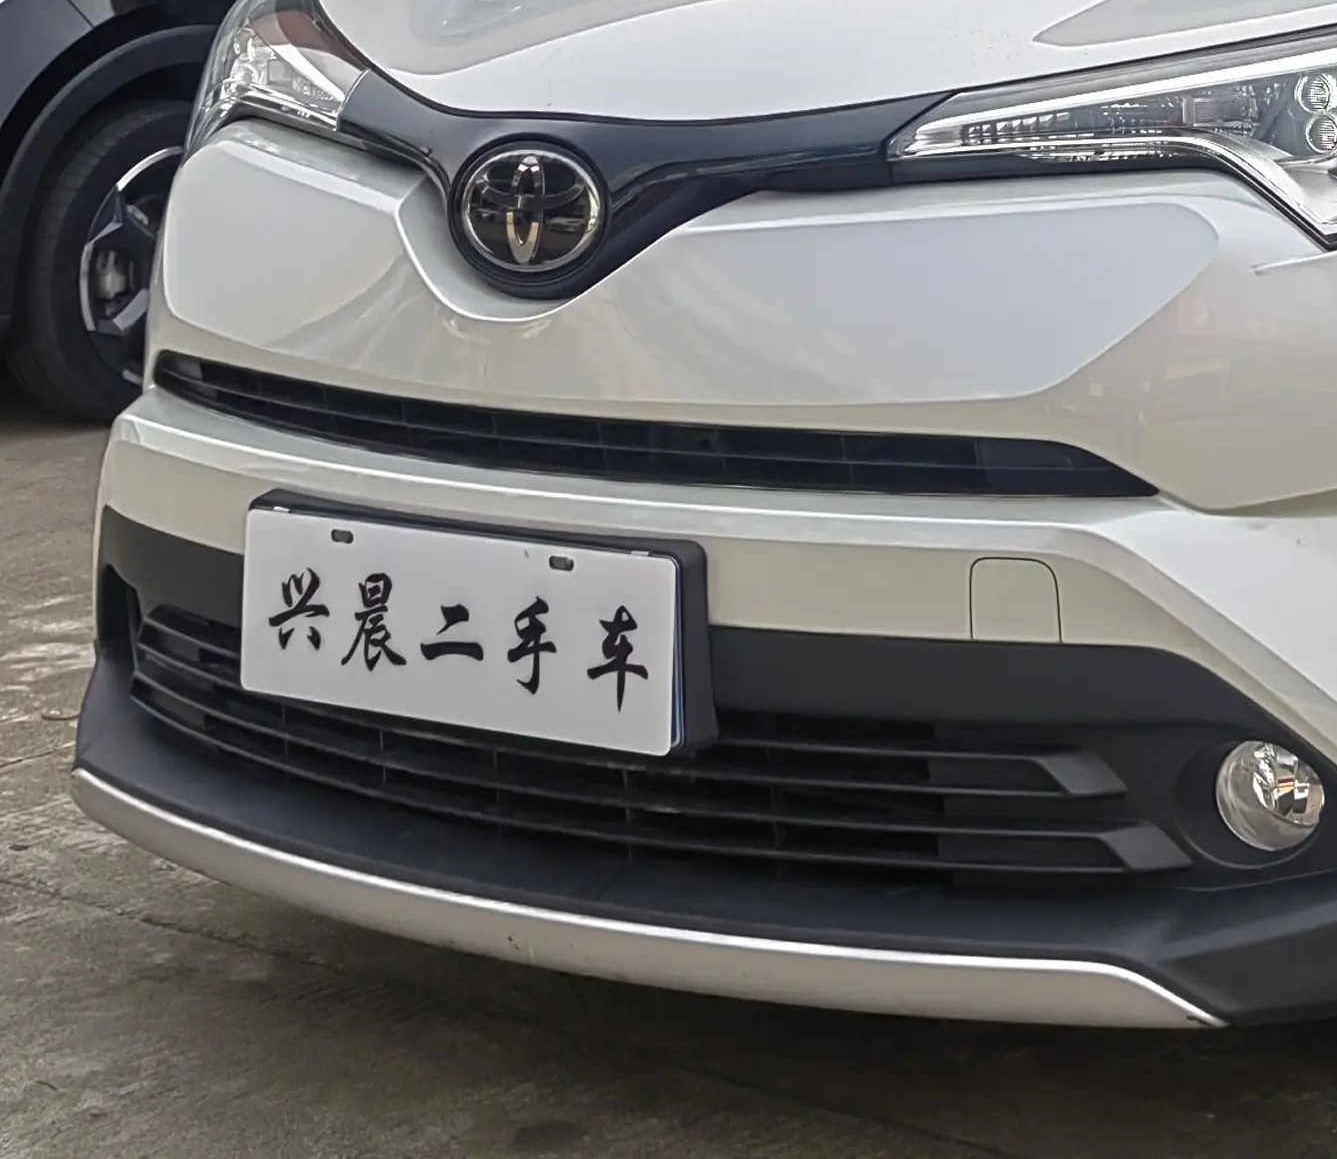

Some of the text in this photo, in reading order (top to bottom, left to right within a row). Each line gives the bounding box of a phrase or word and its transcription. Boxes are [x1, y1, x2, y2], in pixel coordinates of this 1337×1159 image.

[268, 567, 648, 713] 兴晨二手车
